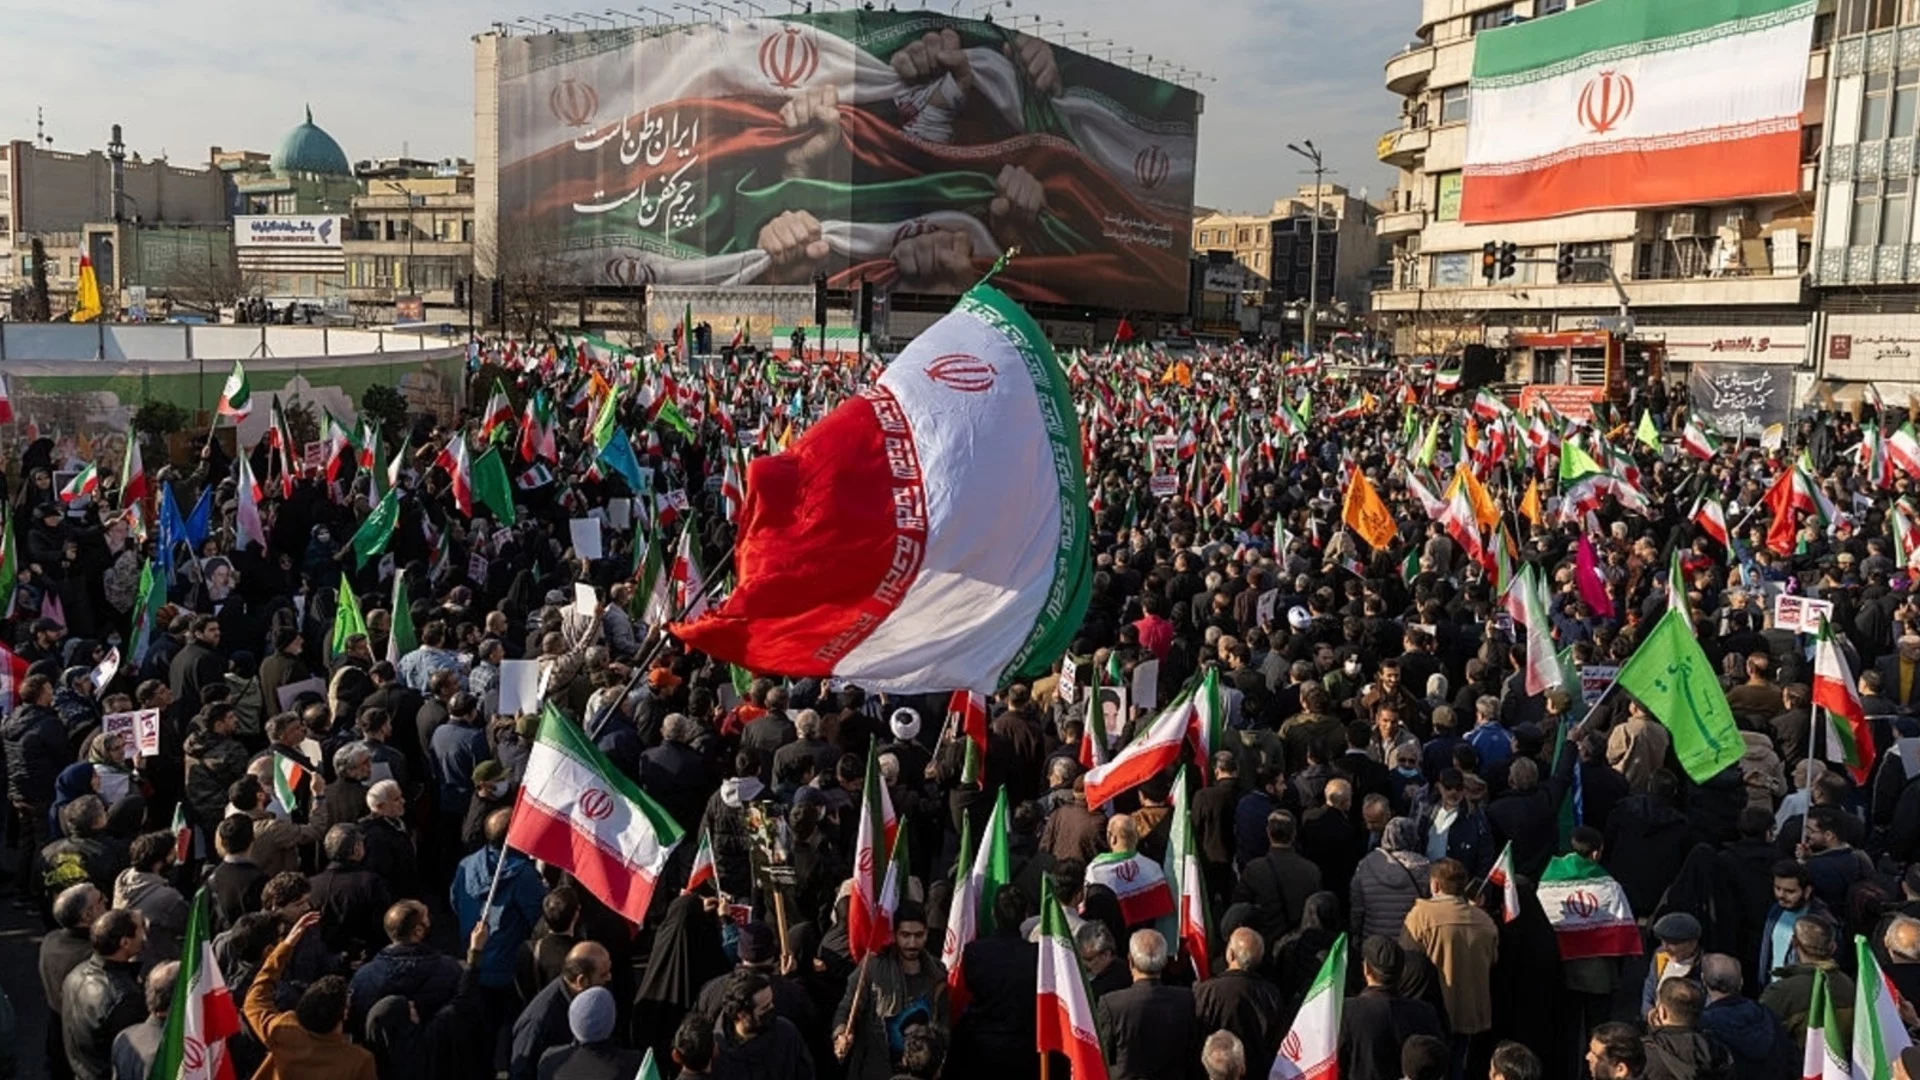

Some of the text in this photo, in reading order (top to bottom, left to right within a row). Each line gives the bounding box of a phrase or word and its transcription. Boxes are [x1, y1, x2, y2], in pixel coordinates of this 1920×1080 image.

[574, 107, 699, 165] ایران وطن ماست
[572, 154, 699, 244] پرچم کفن ماست
